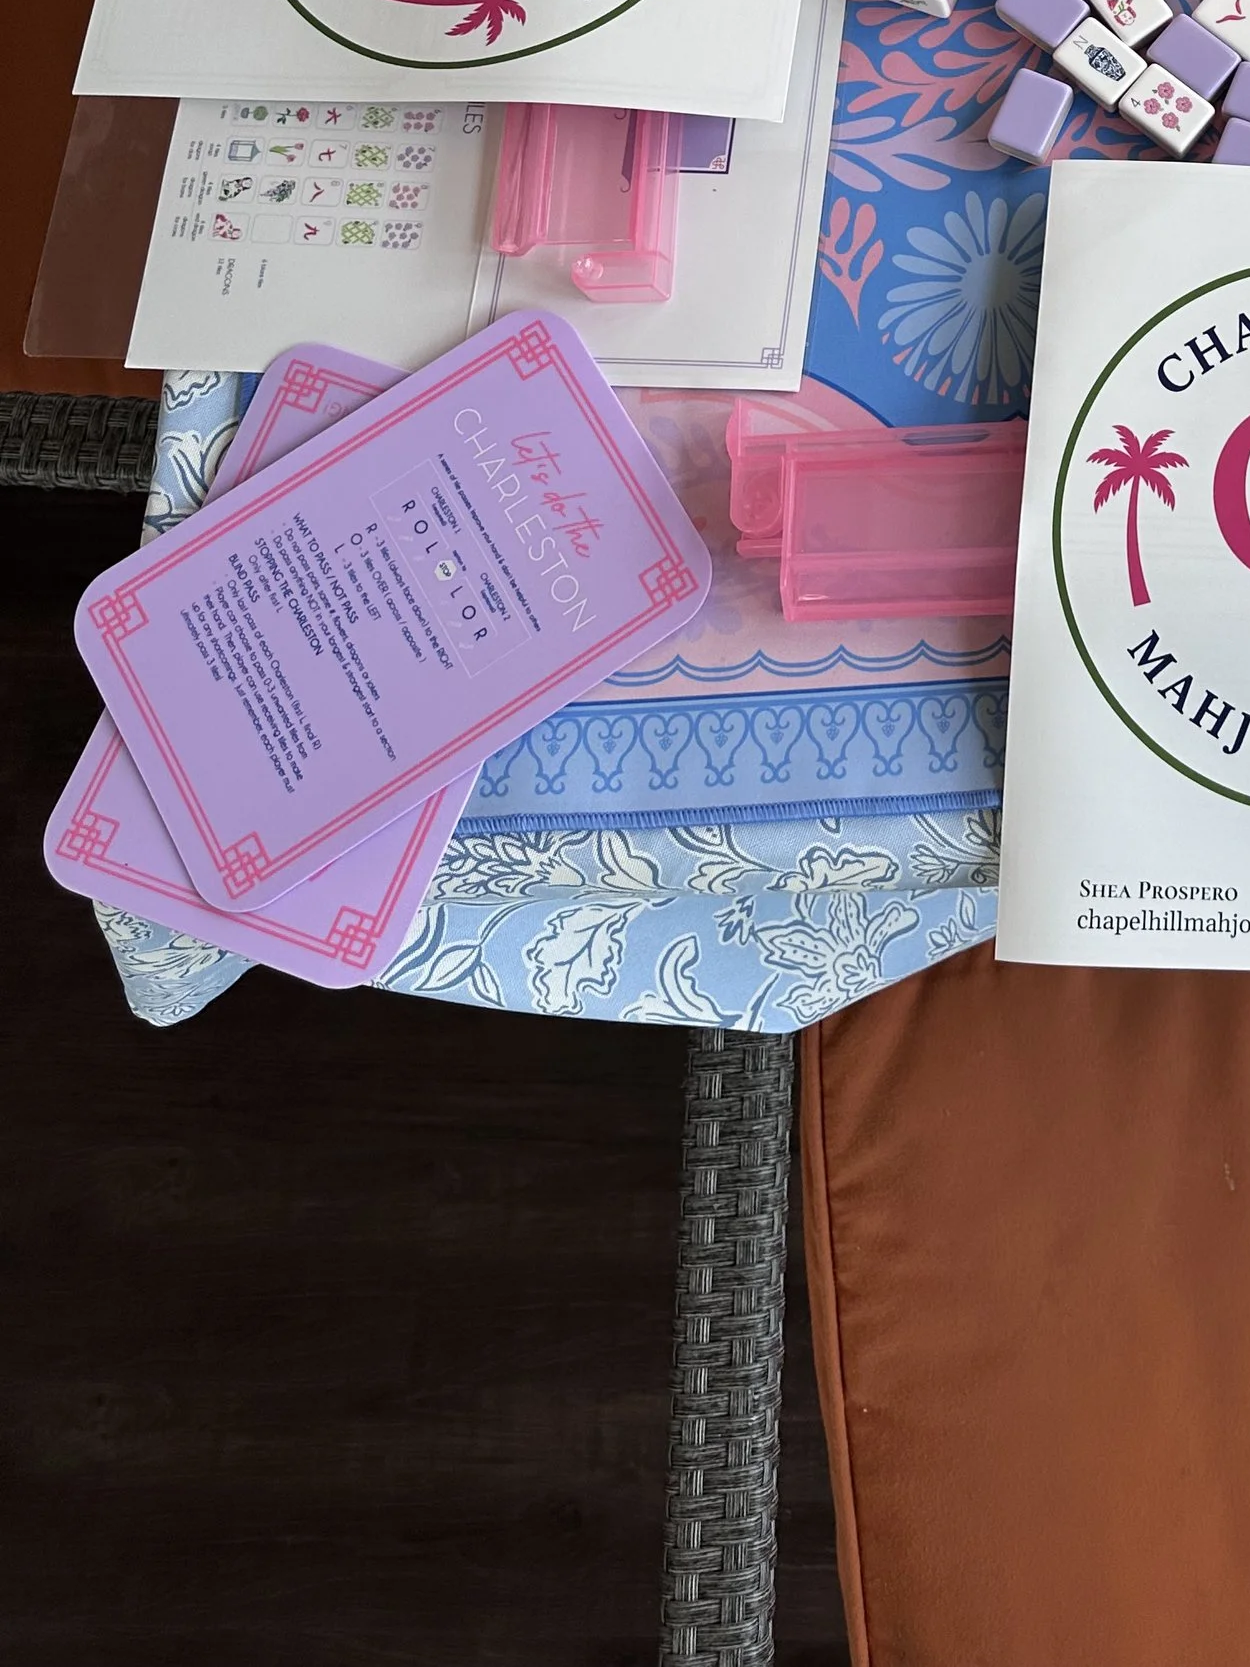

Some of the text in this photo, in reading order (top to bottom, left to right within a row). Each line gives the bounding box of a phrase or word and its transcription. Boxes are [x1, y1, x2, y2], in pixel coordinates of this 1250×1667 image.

[463, 102, 486, 134] ILES
[222, 258, 235, 295] DRAGONS
[431, 486, 457, 528] CHARLESTON
[454, 408, 597, 632] CHARLESTON
[228, 553, 260, 602] BLIND PASS
[248, 554, 261, 573] Only
[258, 574, 271, 592] after
[268, 592, 280, 606] first
[254, 537, 323, 655] STOPPING THE CHARLESTON
[293, 513, 311, 537] WHAT
[307, 537, 319, 552] TO
[314, 551, 331, 574] PASS
[329, 579, 347, 600] NOT
[341, 600, 358, 623] PASS
[334, 543, 344, 553] L
[347, 568, 357, 583] tiles
[355, 582, 363, 592] to
[360, 592, 369, 605] the
[366, 603, 381, 620] LEFT
[350, 533, 362, 545] O
[363, 557, 374, 572] tiles
[372, 570, 388, 593] OVER
[386, 598, 401, 621] across
[401, 626, 421, 657] opposite
[365, 522, 377, 533] R
[380, 546, 390, 561] tiles
[387, 560, 405, 587] (always
[402, 586, 414, 604] face
[411, 604, 429, 627] down)
[424, 626, 432, 636] to
[429, 635, 439, 649] the
[436, 647, 453, 669] RIGHT
[402, 499, 487, 641] R O L STOP L O R
[480, 572, 506, 615] CHARLESTON
